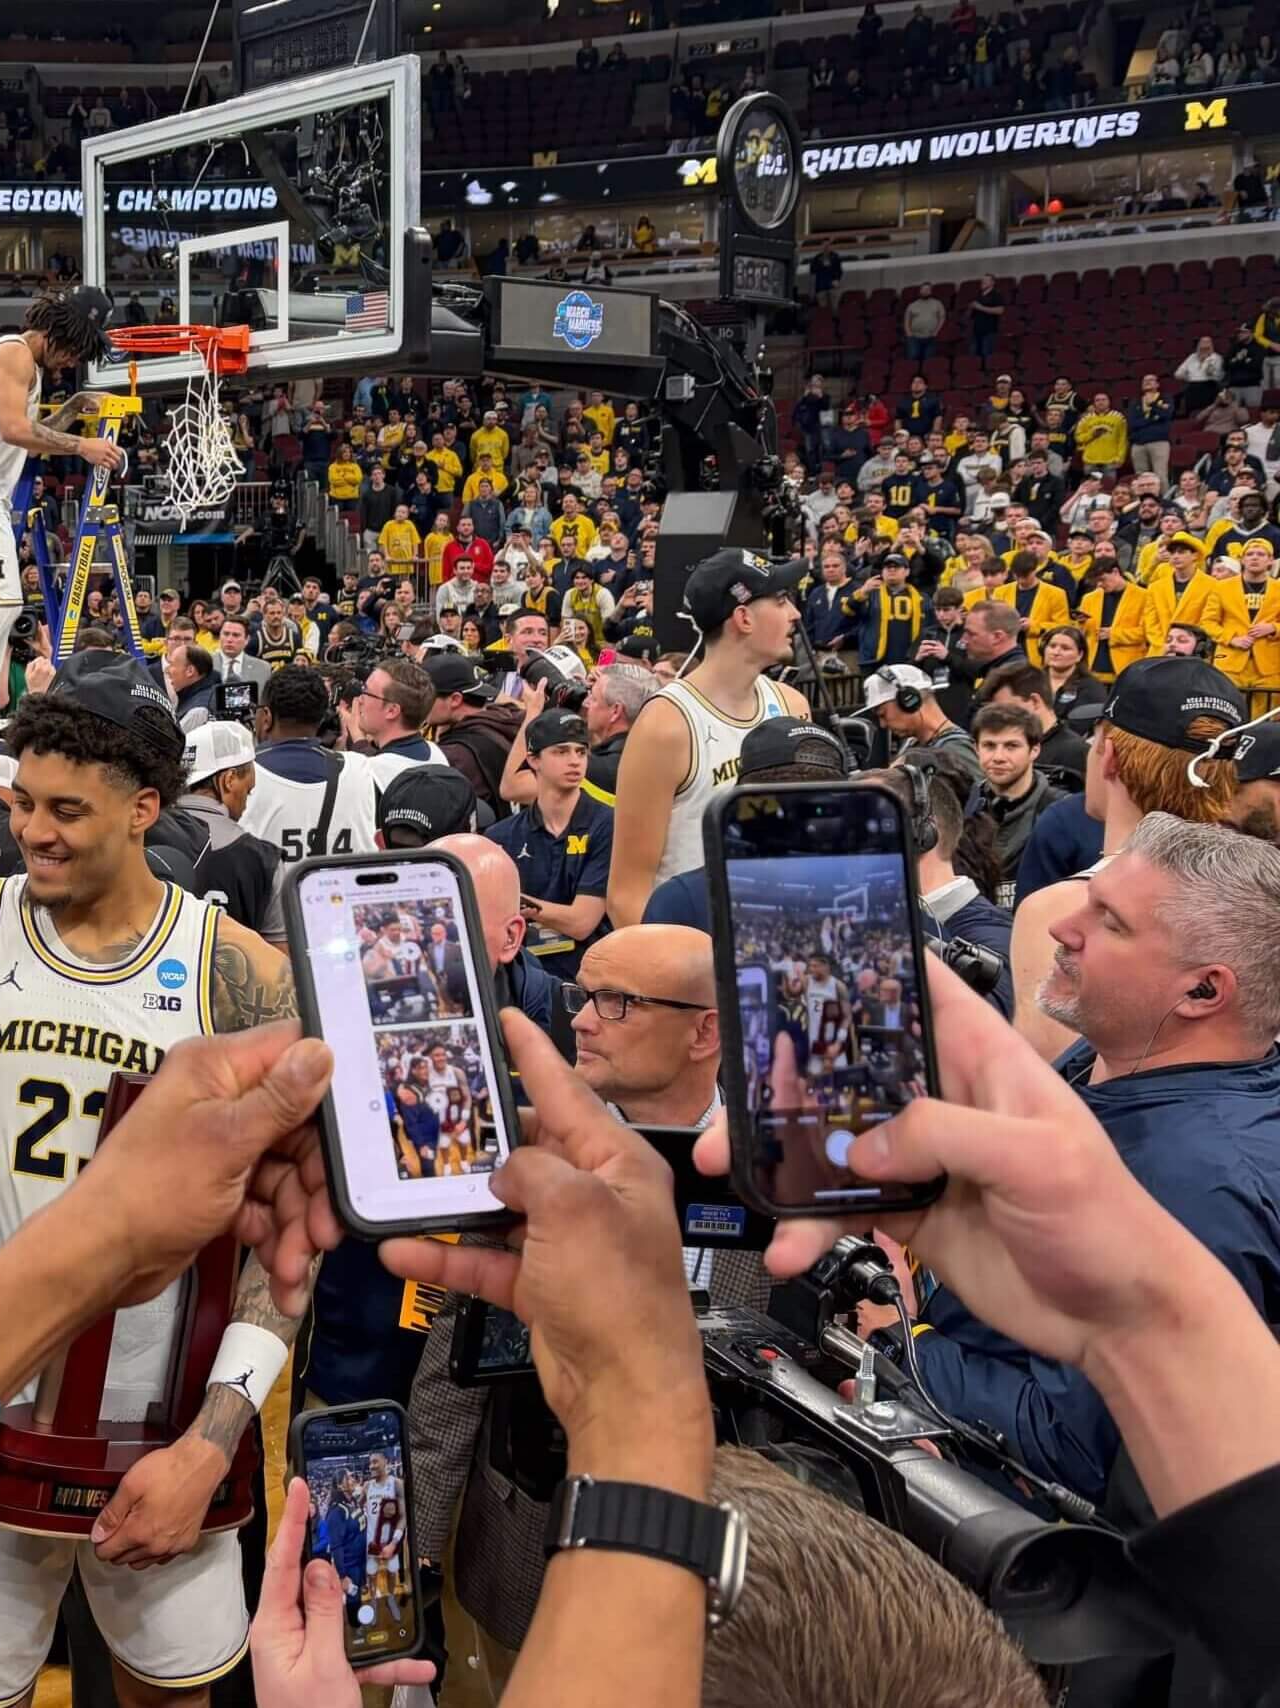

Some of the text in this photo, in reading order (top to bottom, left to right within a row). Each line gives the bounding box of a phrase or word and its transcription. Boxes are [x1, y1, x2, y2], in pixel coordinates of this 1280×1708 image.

[1184, 98, 1228, 130] M
[802, 139, 922, 178] CHIGAN
[929, 111, 1141, 160] WOLVERINES
[889, 485, 912, 507] 10
[71, 543, 92, 607] BASKETBALL
[566, 834, 591, 855] M
[161, 971, 186, 982] NCAA
[55, 1486, 111, 1508] MIDWES
